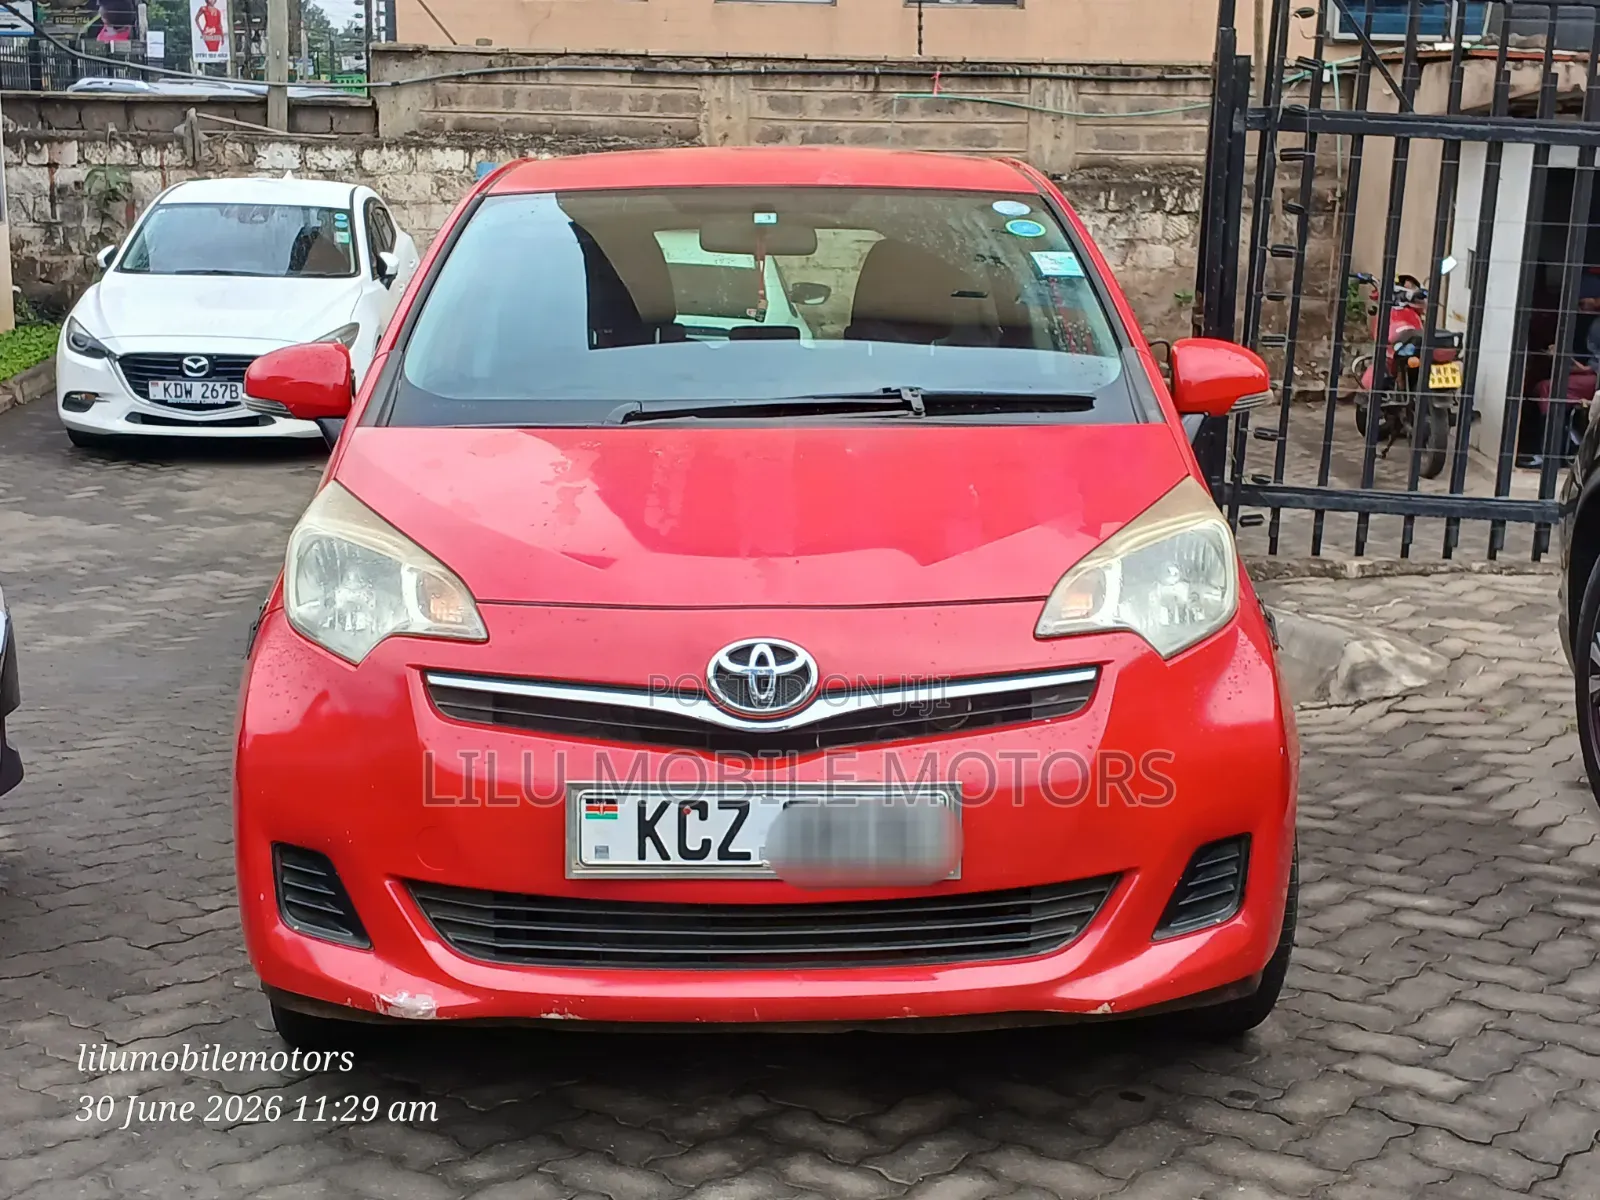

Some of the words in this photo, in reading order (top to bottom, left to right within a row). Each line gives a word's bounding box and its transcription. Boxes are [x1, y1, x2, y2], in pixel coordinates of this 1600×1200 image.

[163, 382, 193, 399] KDW
[201, 382, 239, 400] 267B
[637, 799, 752, 861] KCZ
